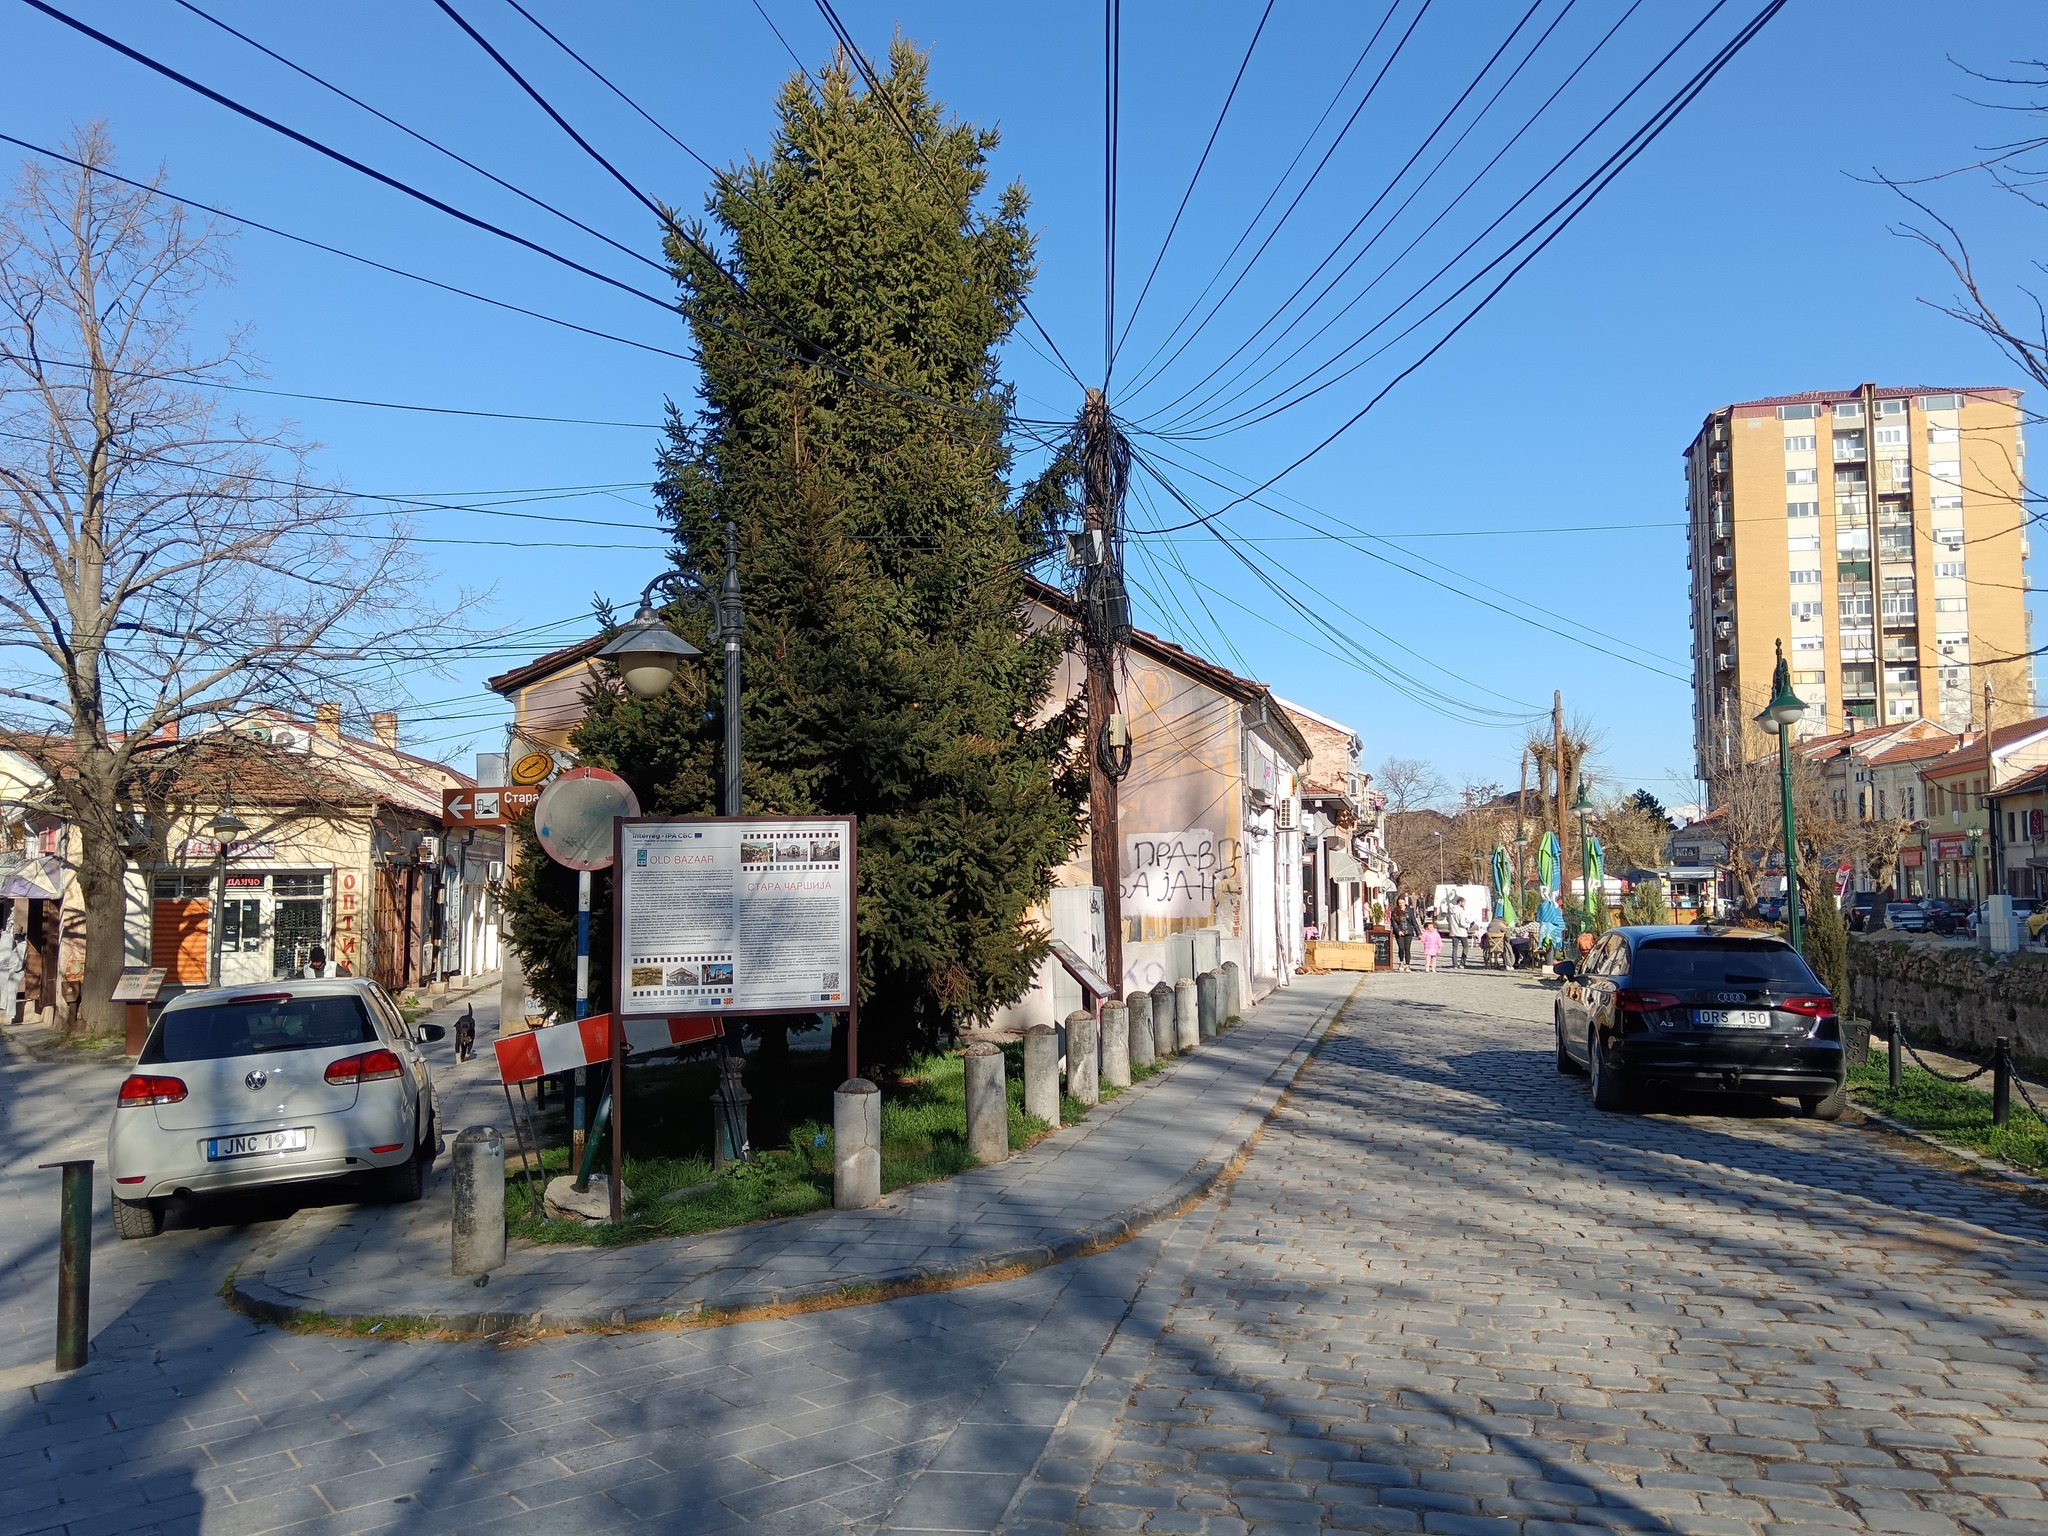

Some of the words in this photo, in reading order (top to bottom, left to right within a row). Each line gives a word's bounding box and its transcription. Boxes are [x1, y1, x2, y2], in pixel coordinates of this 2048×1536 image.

[504, 792, 539, 805] Стара
[650, 856, 670, 864] OLD
[675, 855, 714, 864] BAZAAR
[748, 882, 781, 891] СТАРА
[785, 881, 832, 891] ЧАРШИЈА
[1702, 1011, 1729, 1023] ORS
[1741, 1012, 1766, 1024] 150
[224, 1137, 258, 1154] JNC
[265, 1130, 297, 1150] 191
